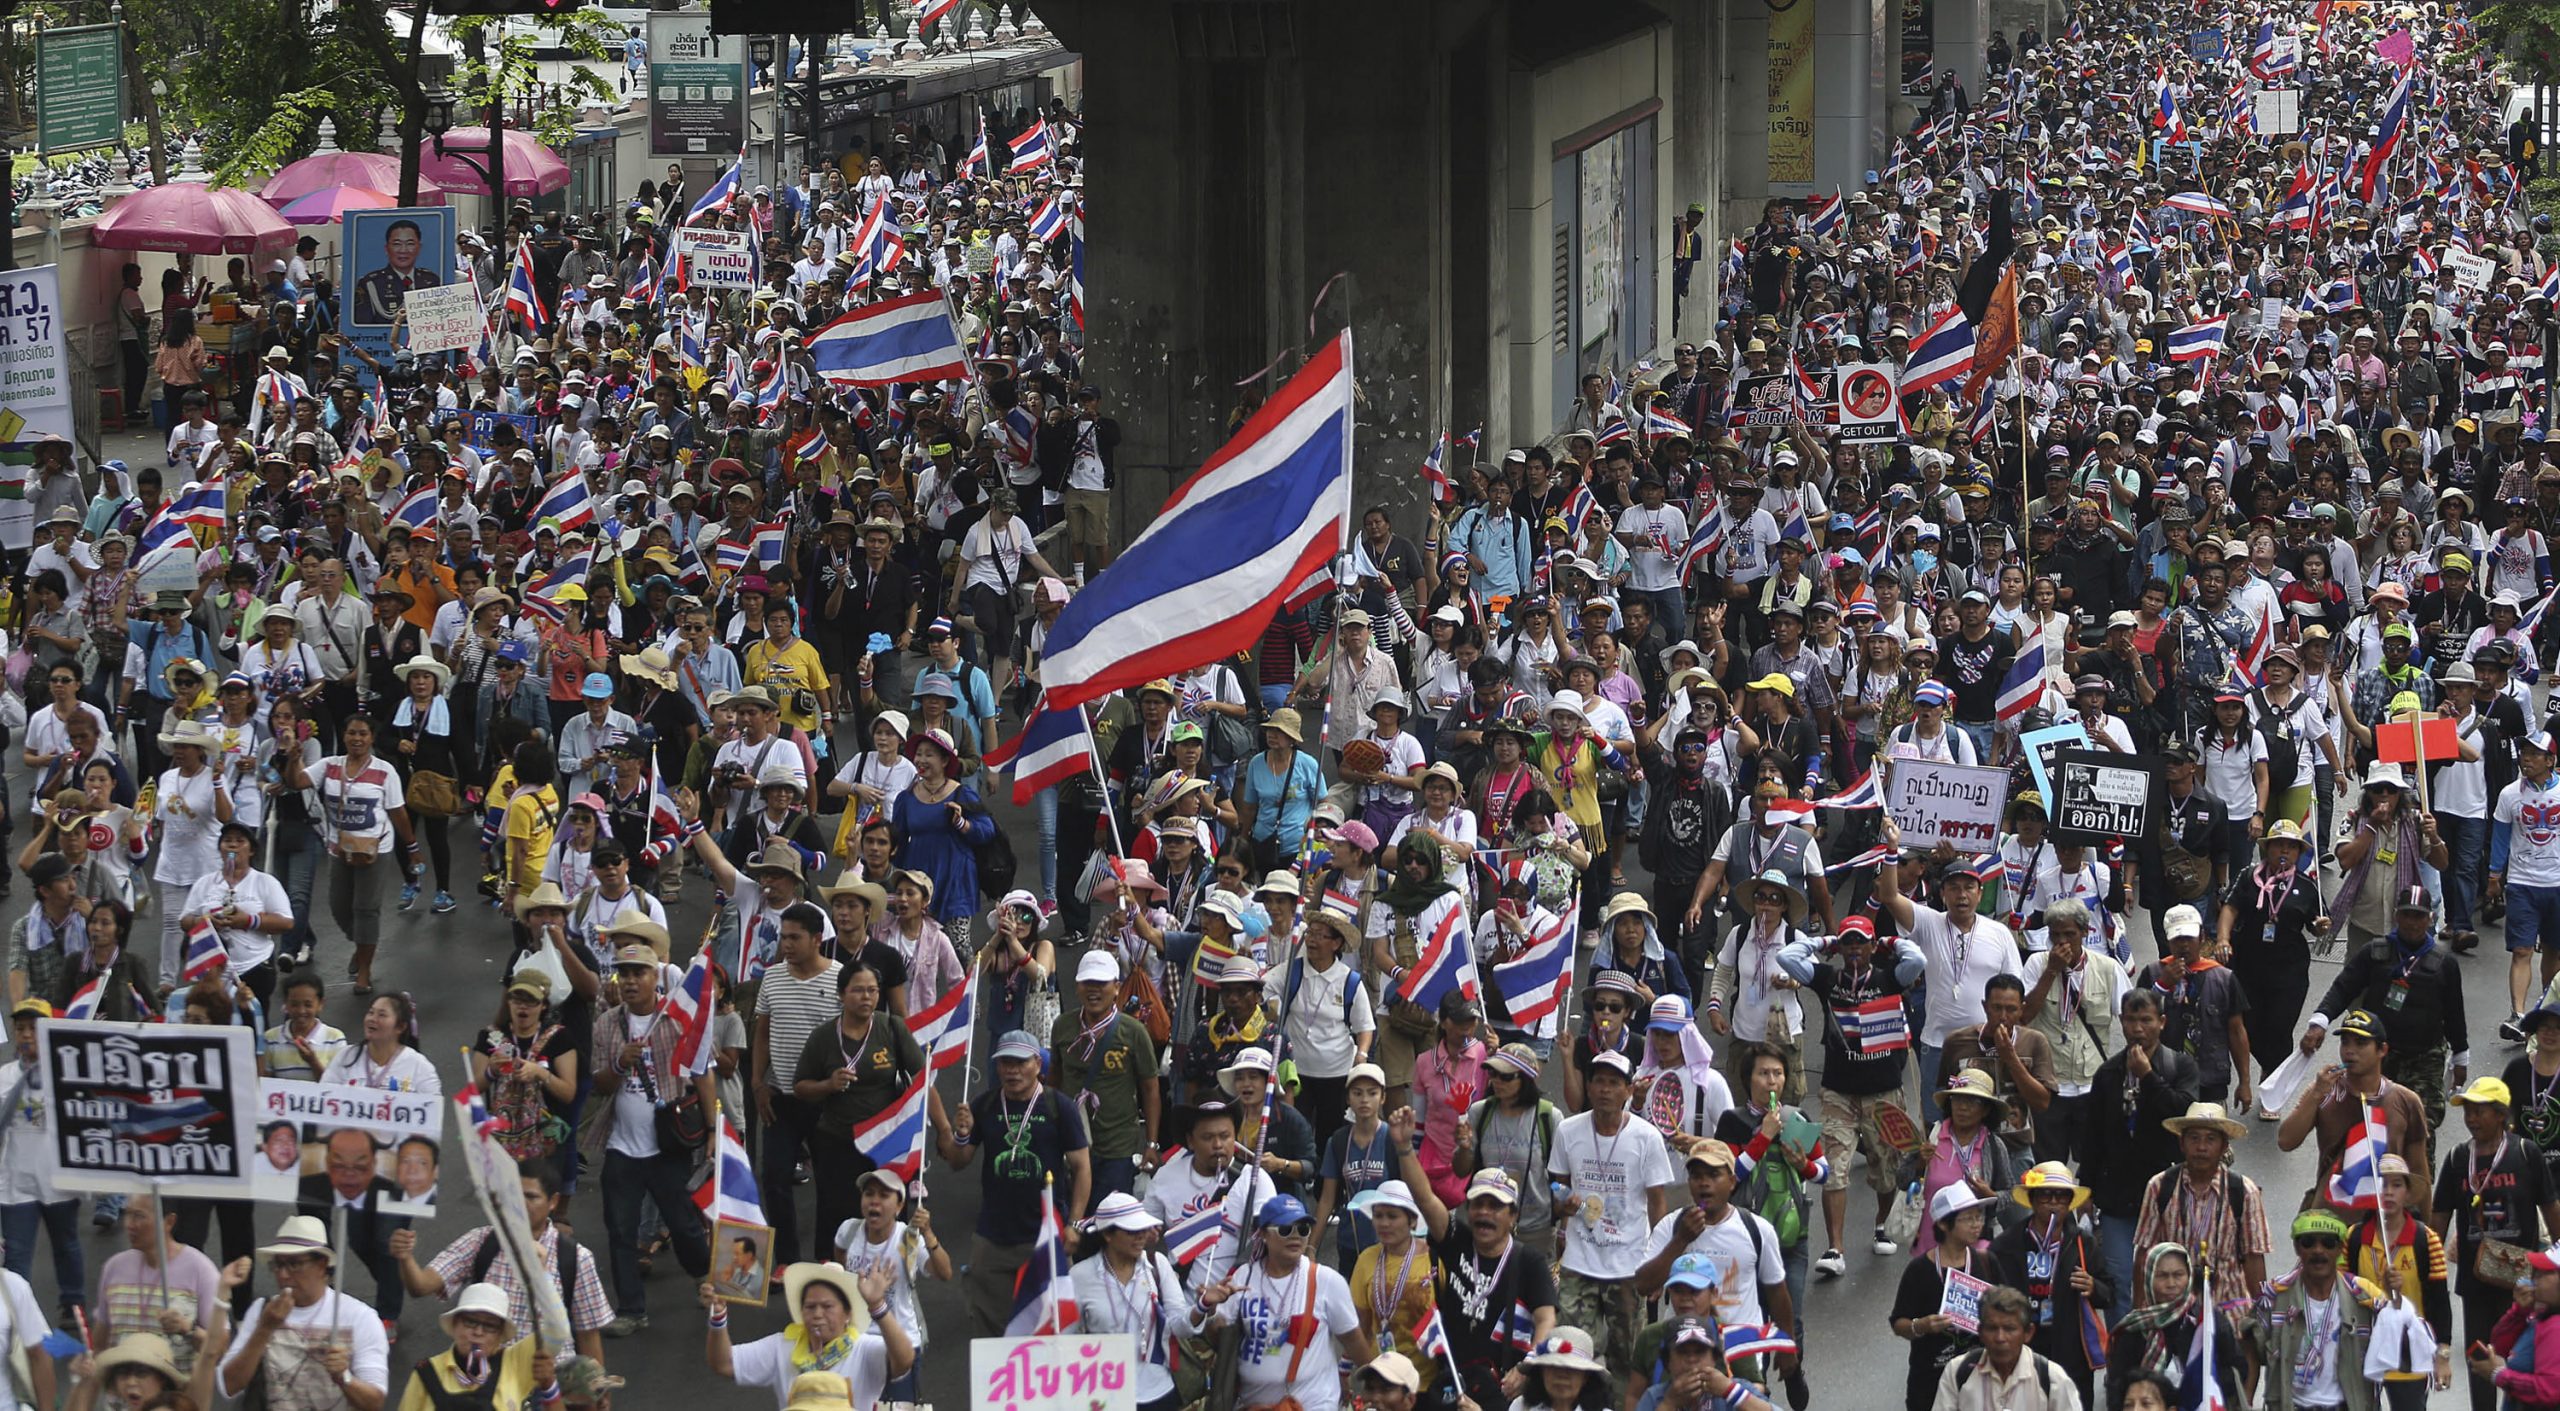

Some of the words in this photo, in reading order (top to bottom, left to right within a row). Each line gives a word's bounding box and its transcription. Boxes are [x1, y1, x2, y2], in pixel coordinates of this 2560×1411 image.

[669, 43, 698, 52] สะอาด
[675, 33, 697, 43] น้ำดื่ม
[708, 253, 746, 267] เขาปีบ
[697, 268, 748, 285] จ.ชุมพ
[27, 316, 51, 342] 57
[4, 367, 55, 387] มีคุณภาพ
[1842, 426, 1862, 437] GET
[1863, 425, 1886, 436] OUT
[2071, 802, 2139, 834] ออกไป!
[873, 1047, 888, 1062] ๙
[1104, 1045, 1128, 1069] ๙
[57, 1035, 224, 1103] ปฏิรูป
[64, 1091, 128, 1121] ก่อน
[267, 1088, 433, 1126] ศูนย์รวมสัตว์
[65, 1125, 232, 1173] เลือกตั้ง
[1249, 1318, 1268, 1339] IS
[987, 1340, 1125, 1411] สุโขทัย
